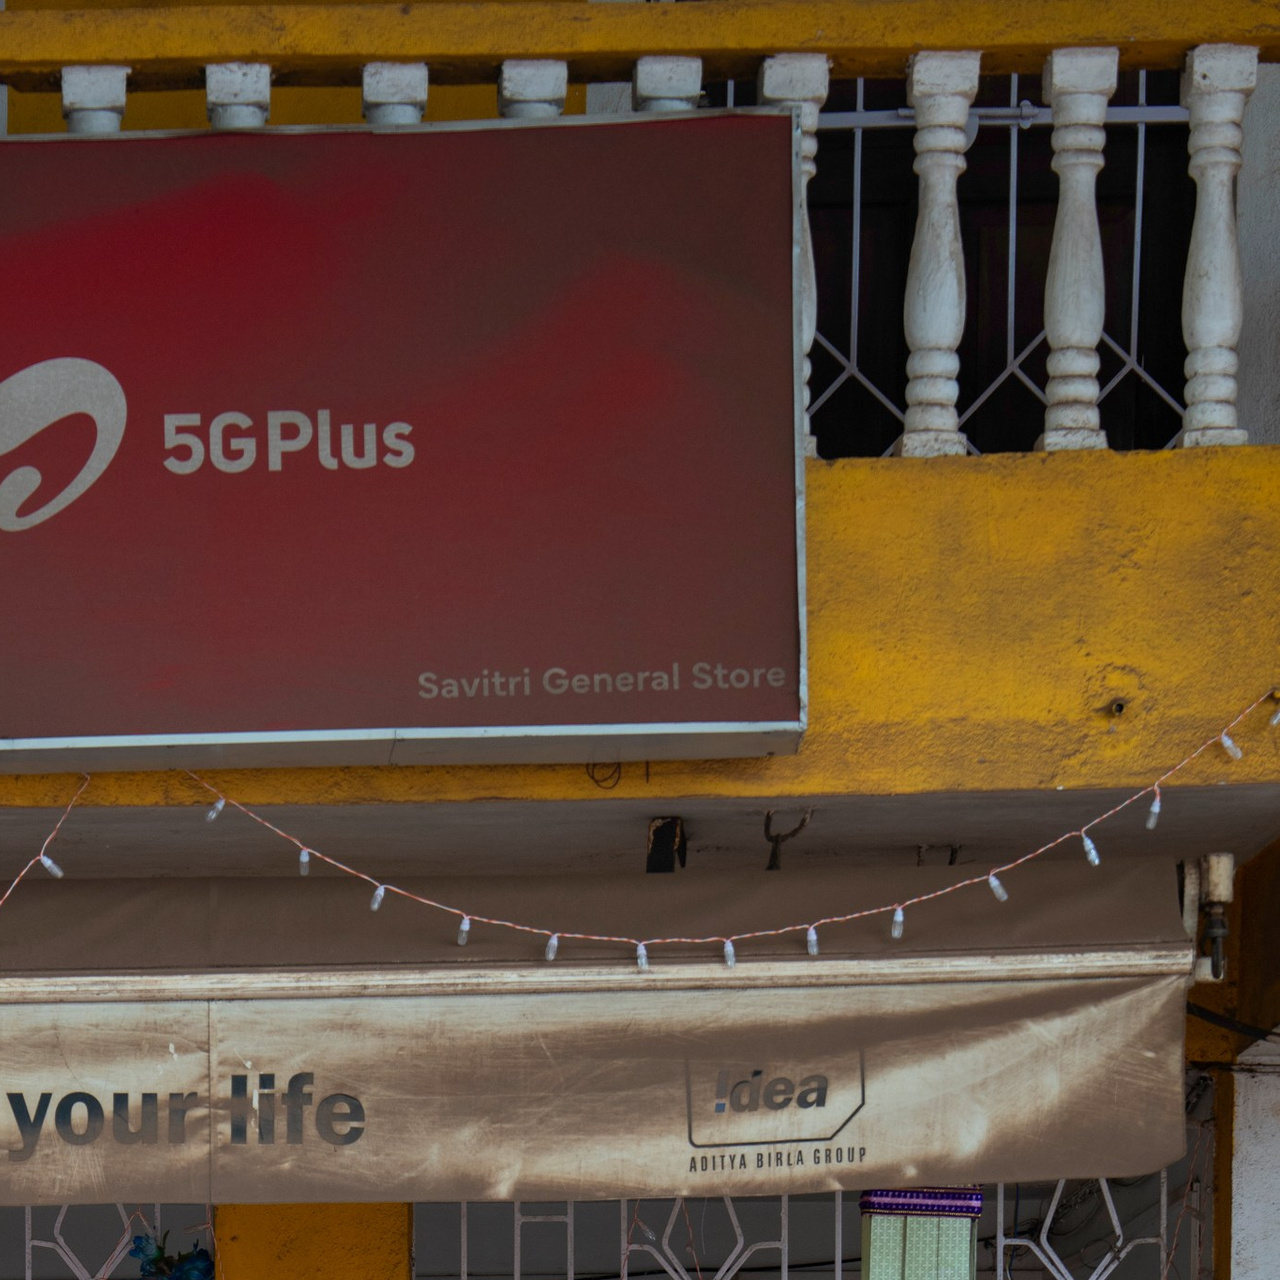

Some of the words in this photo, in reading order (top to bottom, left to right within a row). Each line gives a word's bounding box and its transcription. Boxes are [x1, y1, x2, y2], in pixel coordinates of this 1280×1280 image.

[418, 667, 531, 700] Savitri
[542, 662, 680, 695] General
[692, 661, 786, 691] Store
[6, 1091, 199, 1162] your
[230, 1072, 366, 1146] life
[689, 1152, 747, 1173] ADITYA
[756, 1149, 804, 1168] BIRLA
[813, 1146, 867, 1165] GROUP
